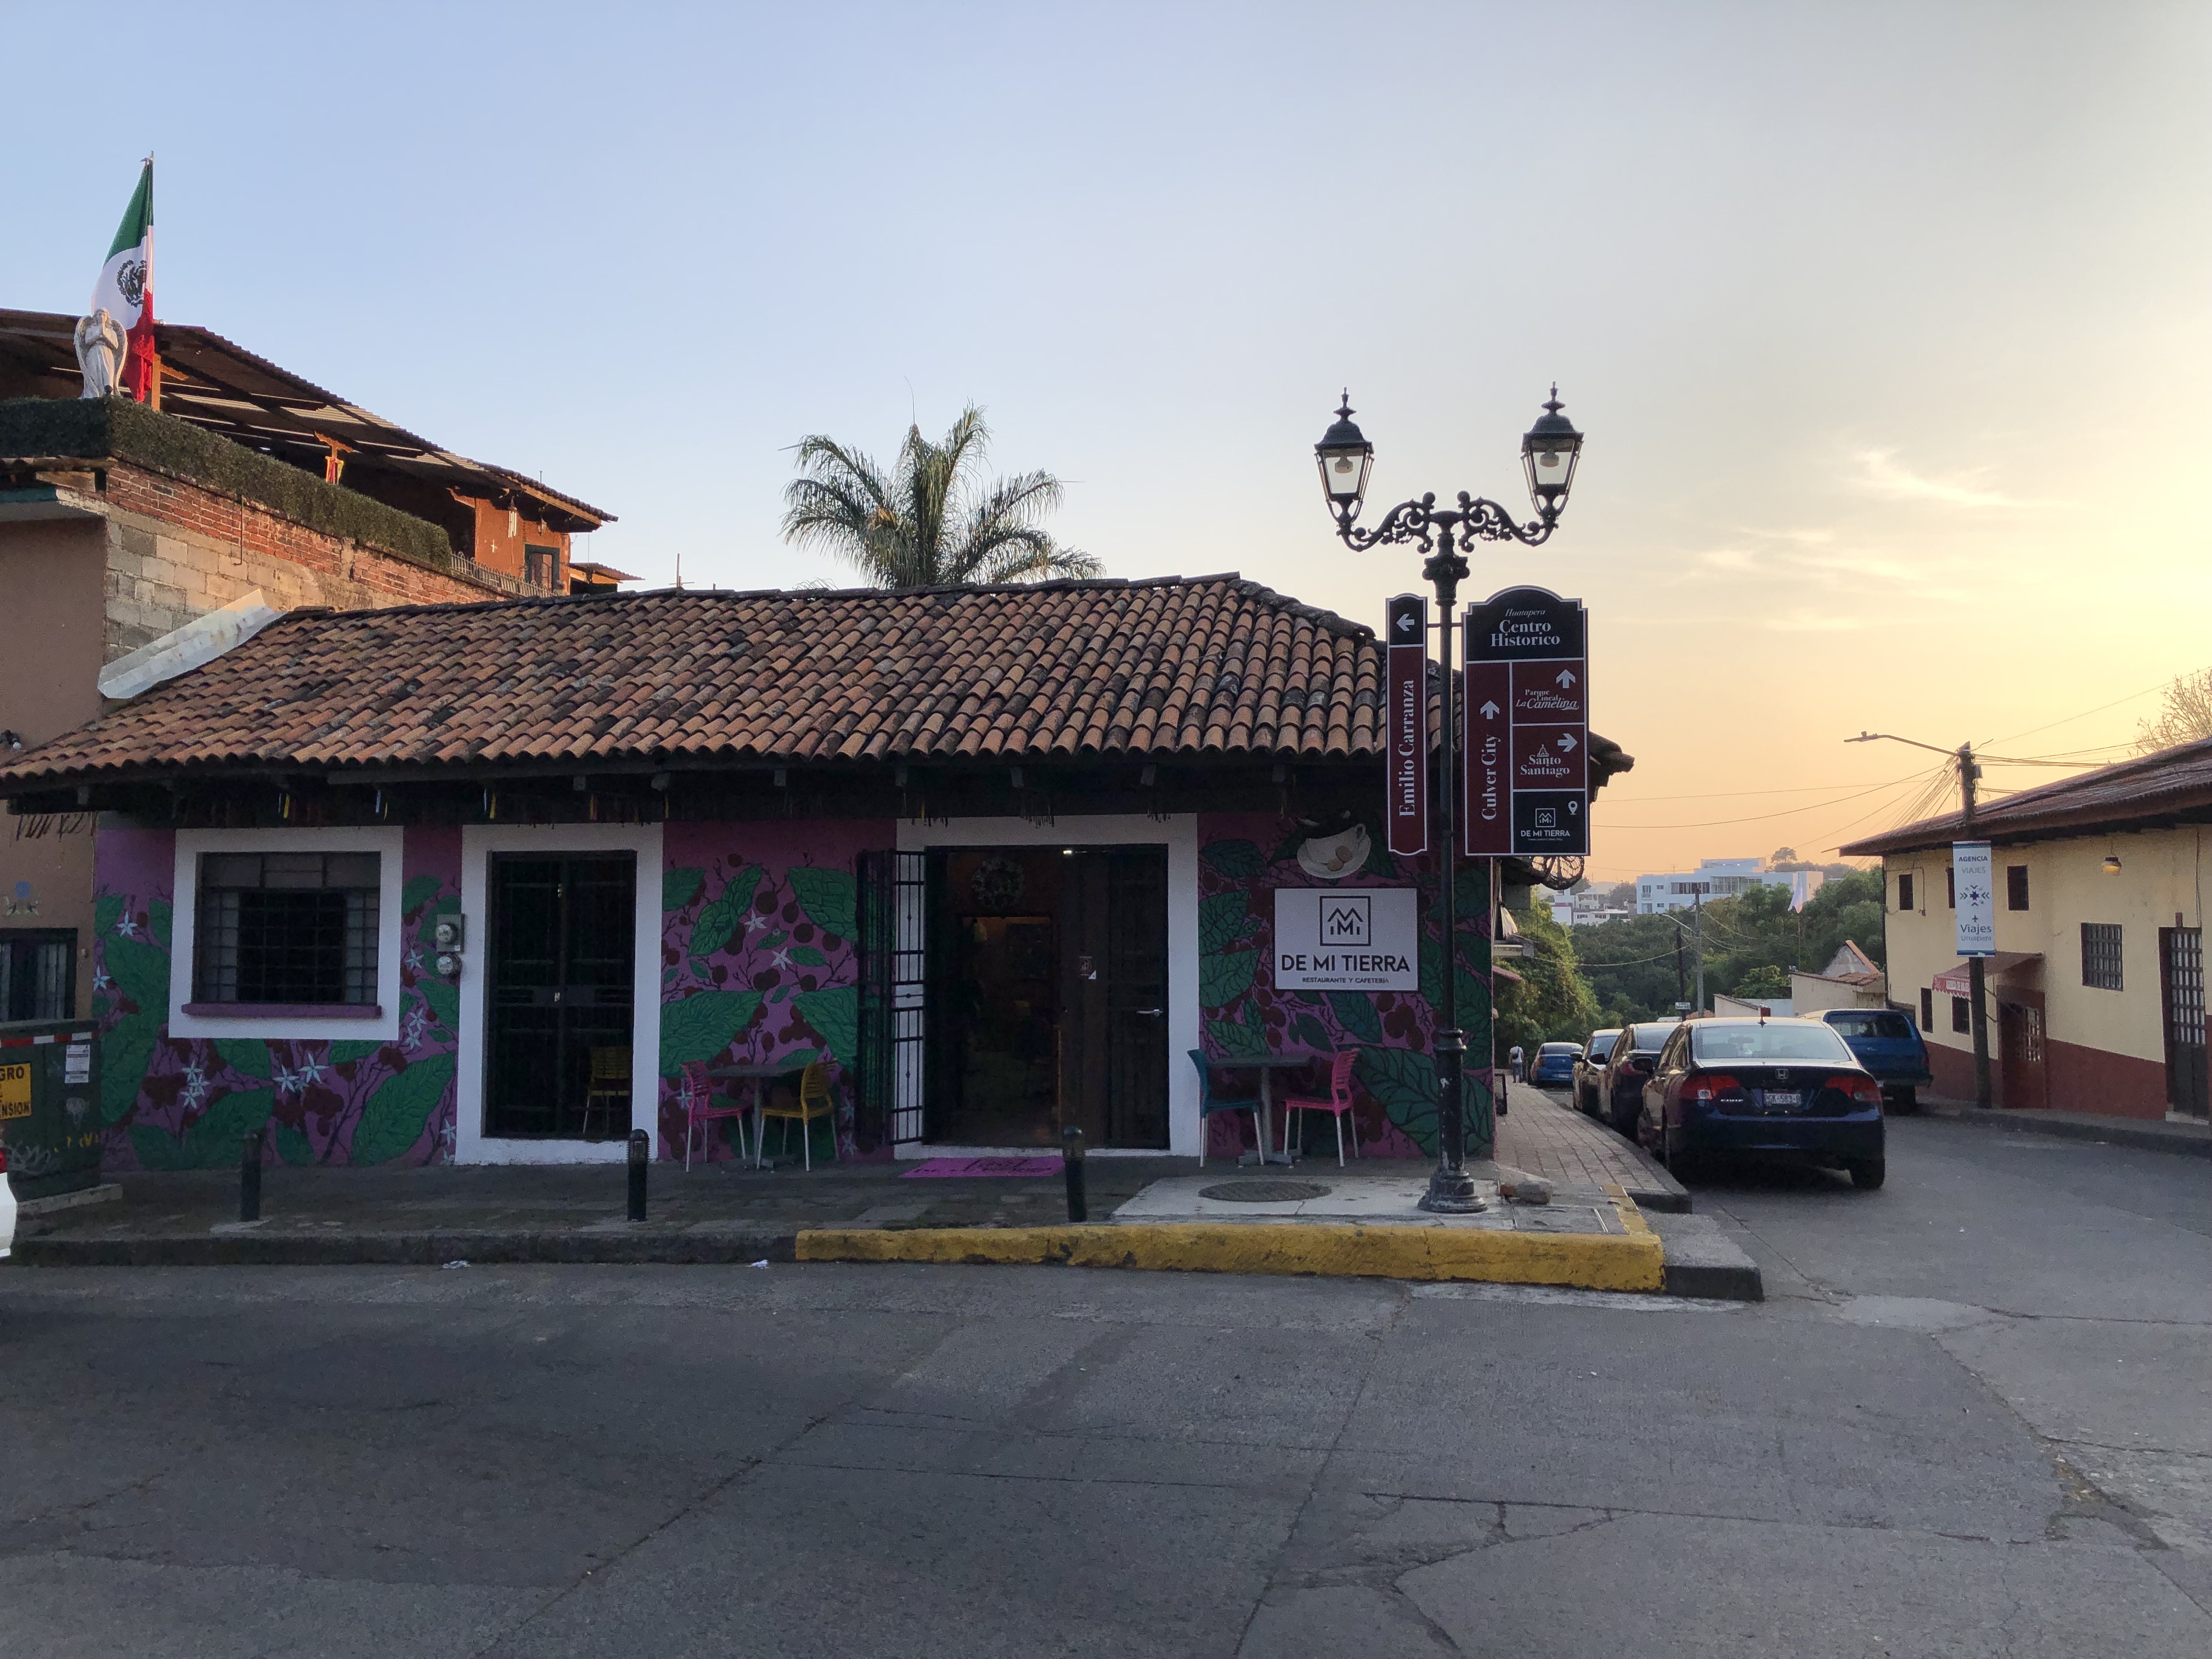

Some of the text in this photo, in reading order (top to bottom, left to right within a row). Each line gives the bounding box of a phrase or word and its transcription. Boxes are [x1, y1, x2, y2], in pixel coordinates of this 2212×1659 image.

[1505, 608, 1546, 618] Huatapera
[1499, 619, 1551, 633] Centro
[1490, 632, 1560, 647] Historico
[1515, 697, 1579, 710] La Camelina
[1398, 680, 1415, 817] Emilio Carranza
[1528, 754, 1561, 765] Santo
[1481, 733, 1501, 820] Culver City
[1520, 764, 1570, 778] Santiago
[1960, 924, 1992, 934] Viajes
[1281, 954, 1410, 972] DE MI TIERRA
[0, 1102, 30, 1117] NSION
